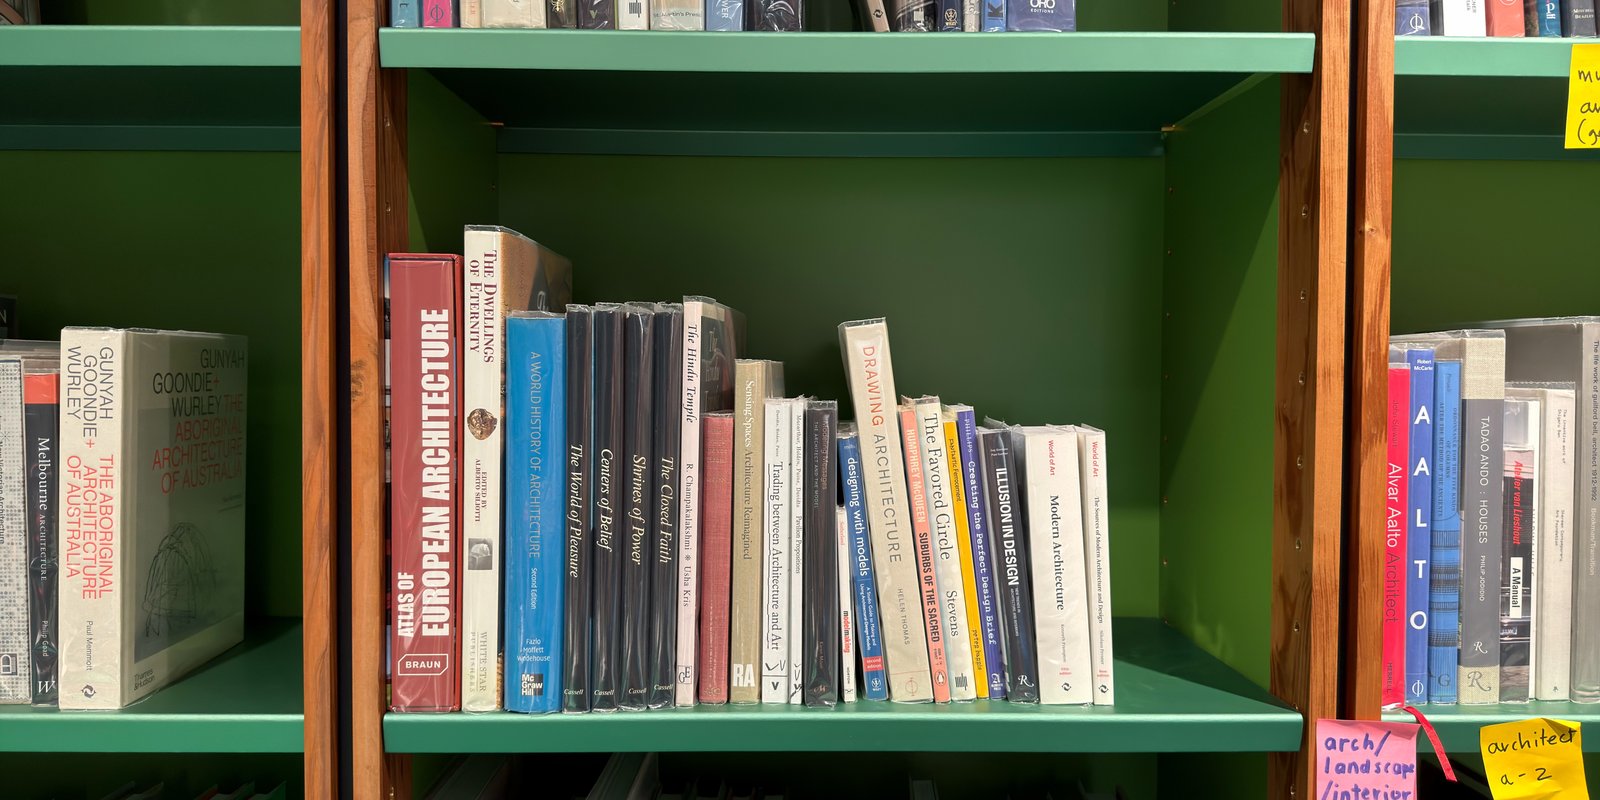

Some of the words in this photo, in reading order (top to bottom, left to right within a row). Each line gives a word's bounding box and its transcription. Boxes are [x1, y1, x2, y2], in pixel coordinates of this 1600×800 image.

[469, 282, 483, 353] ETERNITY
[687, 323, 699, 344] The
[200, 349, 245, 370] GUNYAH
[529, 351, 541, 359] A
[1592, 340, 1600, 353] The
[1592, 354, 1600, 366] life
[686, 347, 698, 382] Hindu
[1592, 366, 1600, 384] work
[66, 346, 81, 420] WURLEY
[99, 346, 114, 420] GUNYAH
[529, 361, 541, 404] WORLD
[743, 380, 756, 416] Sensing
[863, 346, 885, 426] DRAWING
[1592, 385, 1600, 394] of
[170, 395, 221, 418] WURLEY
[223, 392, 243, 414] THE
[420, 308, 450, 501] ARCHITECTURE
[683, 386, 698, 423] Temple
[1391, 399, 1399, 418] John
[1590, 394, 1600, 420] guilford
[175, 415, 243, 443] ABORIGINAL
[529, 405, 541, 455] HISTORY
[743, 417, 755, 448] Spaces
[924, 413, 939, 444] The
[1391, 419, 1399, 448] Stewart
[1479, 416, 1490, 452] TADAO
[1590, 420, 1599, 436] bell,
[66, 454, 81, 479] OF
[152, 440, 243, 471] ARCHITECTURE
[529, 456, 541, 472] OF
[569, 443, 583, 467] The
[906, 428, 920, 478] HUMPHREY
[1091, 441, 1099, 460] World
[1590, 436, 1599, 468] architect
[37, 437, 50, 511] Melbourne
[99, 454, 114, 490] THE
[160, 473, 180, 496] OF
[182, 465, 243, 492] AUSTRALIA
[599, 448, 614, 494] Centers
[632, 455, 646, 503] Shrines
[660, 456, 674, 481] The
[686, 463, 694, 472] R.
[743, 449, 755, 506] Architecture
[770, 461, 784, 501] Trading
[847, 457, 861, 508] designing
[927, 447, 949, 508] Favored
[1387, 462, 1402, 502] Alvar
[1479, 454, 1490, 486] ANDO
[1513, 460, 1524, 491] Atelier
[569, 470, 583, 507] World
[873, 434, 902, 563] ARCHITECTURE
[968, 460, 980, 509] Creating
[995, 467, 1012, 523] ILLUSION
[1514, 491, 1522, 507] van
[481, 499, 488, 510] BY
[529, 473, 541, 559] ARCHITECTURE
[566, 510, 582, 526] of
[596, 498, 613, 513] of
[628, 507, 646, 524] of
[660, 484, 674, 526] Closed
[684, 475, 694, 551] Champakalakshmi
[912, 480, 926, 523] McQUEEN
[1049, 495, 1062, 539] Modern
[66, 483, 81, 579] AUSTRALIA
[82, 464, 98, 600] ARCHITECTURE
[596, 514, 614, 552] Belief
[741, 507, 753, 560] Reimagined
[772, 503, 783, 545] between
[853, 509, 865, 535] with
[934, 513, 954, 560] Circle
[974, 511, 983, 530] the
[1002, 525, 1014, 538] IN
[1387, 506, 1403, 549] Aalto
[1478, 499, 1489, 545] HOUSES
[1513, 508, 1523, 545] Lieshout
[39, 513, 48, 581] ARCHITECTURE
[99, 494, 114, 599] ABORIGINAL
[569, 526, 583, 578] Pleasure
[631, 525, 645, 565] Power
[659, 531, 673, 563] Faith
[856, 536, 870, 577] models
[918, 532, 933, 574] SUBURBS
[976, 533, 988, 574] Perfect
[421, 506, 450, 637] EUROPEAN
[530, 567, 538, 588] Second
[683, 566, 692, 587] Usha
[771, 547, 783, 609] Architecture
[1003, 540, 1020, 586] DESIGN
[1052, 541, 1066, 611] Architecture
[1095, 559, 1104, 593] Architecture
[398, 572, 414, 591] OF
[924, 575, 934, 587] OF
[926, 588, 937, 606] THE
[980, 576, 992, 613] Design
[1385, 552, 1401, 624] Architect
[1512, 575, 1521, 608] Manual
[530, 589, 538, 610] Edition
[682, 589, 691, 608] Kris
[897, 588, 906, 613] HELEN
[945, 590, 960, 637] Stevens
[1097, 604, 1105, 625] Design
[41, 620, 49, 640] Philip
[398, 594, 414, 638] ATLAS
[771, 612, 783, 631] and
[842, 610, 851, 654] modelmaking
[899, 615, 910, 645] THOMAS
[927, 607, 940, 643] SACRED
[986, 615, 997, 646] Brief
[479, 631, 488, 665] WHITE
[771, 633, 782, 650] Art
[405, 660, 442, 669] BRAUN
[479, 666, 488, 692] STAR
[733, 663, 756, 688] RA
[521, 681, 543, 689] Graw
[521, 688, 533, 696] Hill
[1324, 730, 1391, 757] arch/
[1487, 727, 1577, 755] architect
[1323, 756, 1415, 779] landscape
